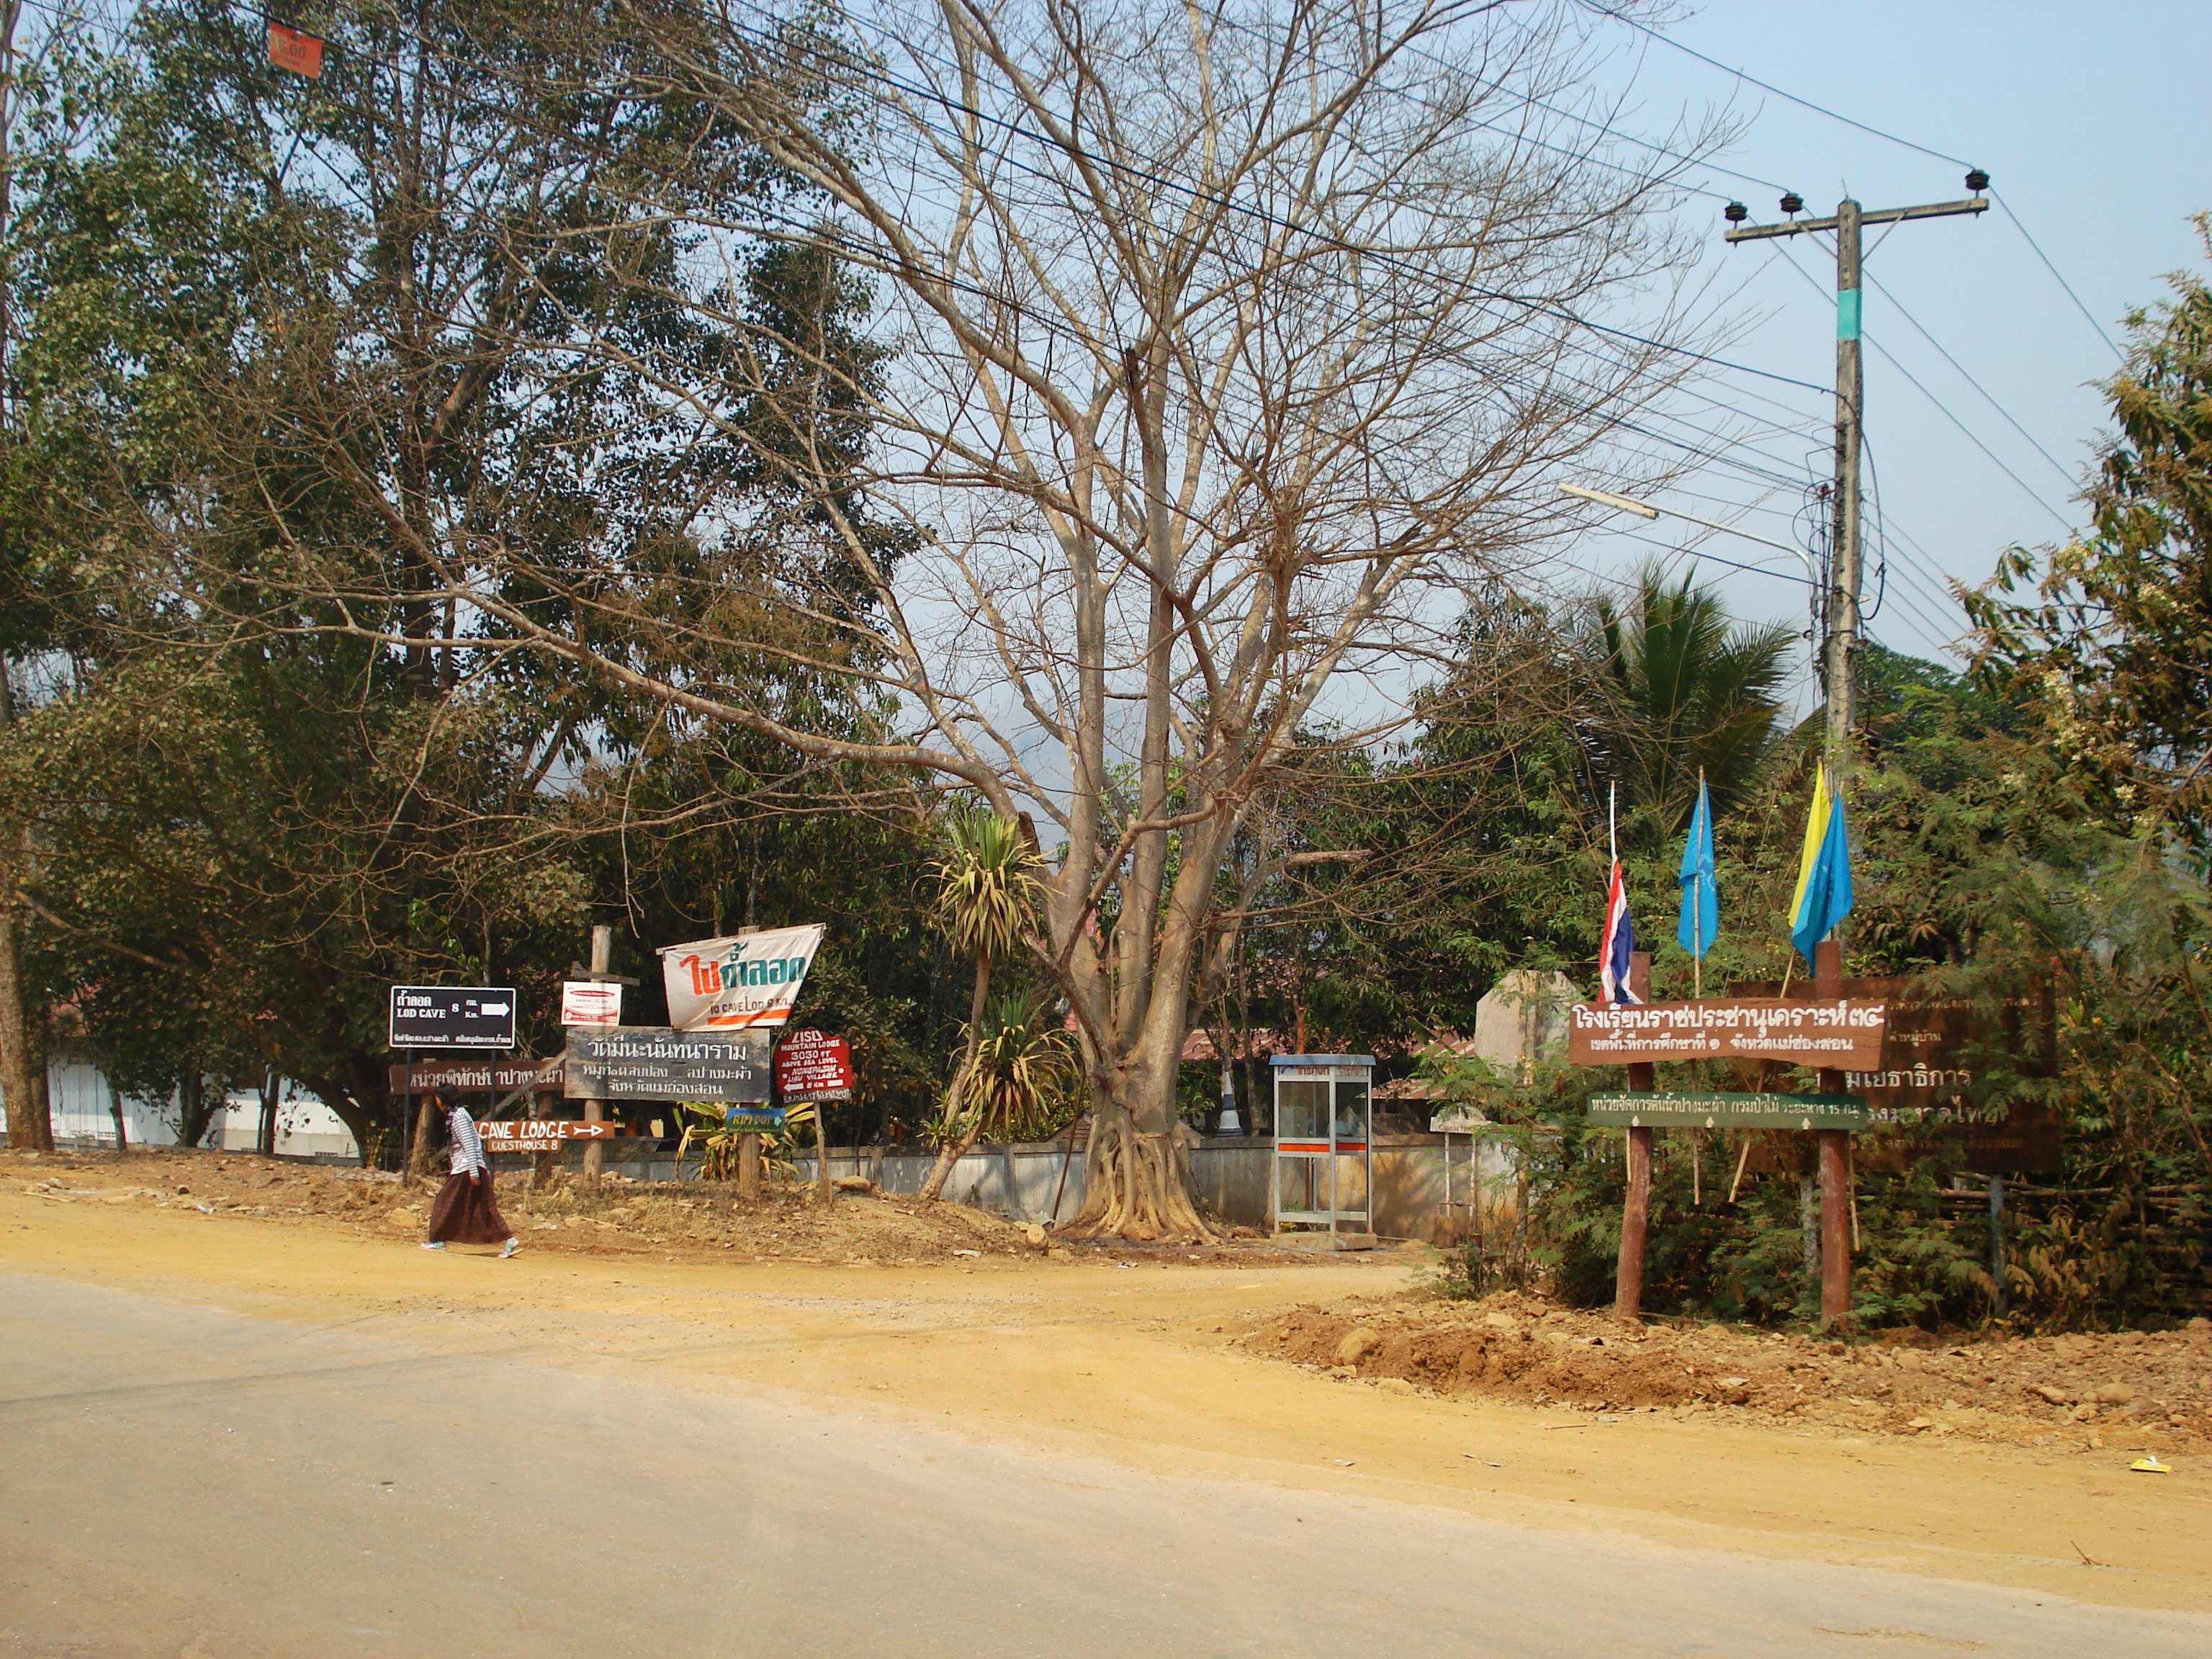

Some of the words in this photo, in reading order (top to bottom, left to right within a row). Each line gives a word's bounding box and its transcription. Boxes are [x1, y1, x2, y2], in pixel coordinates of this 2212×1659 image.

[397, 989, 432, 1007] ถ้ำลอด
[722, 1002, 744, 1012] CAVE
[745, 996, 765, 1011] LOD
[767, 998, 774, 1008] 9
[397, 1009, 417, 1018] LOD
[419, 1009, 446, 1019] CAVE
[451, 1003, 459, 1013] 8
[791, 1030, 824, 1043] LISU
[781, 1042, 817, 1051] MOUNTAIN
[818, 1039, 840, 1048] LODGE
[806, 1071, 838, 1080] VILLAGE
[478, 1122, 515, 1139] CAVE
[520, 1121, 569, 1138] LODGE
[491, 1140, 548, 1151] GUESTHOUSE
